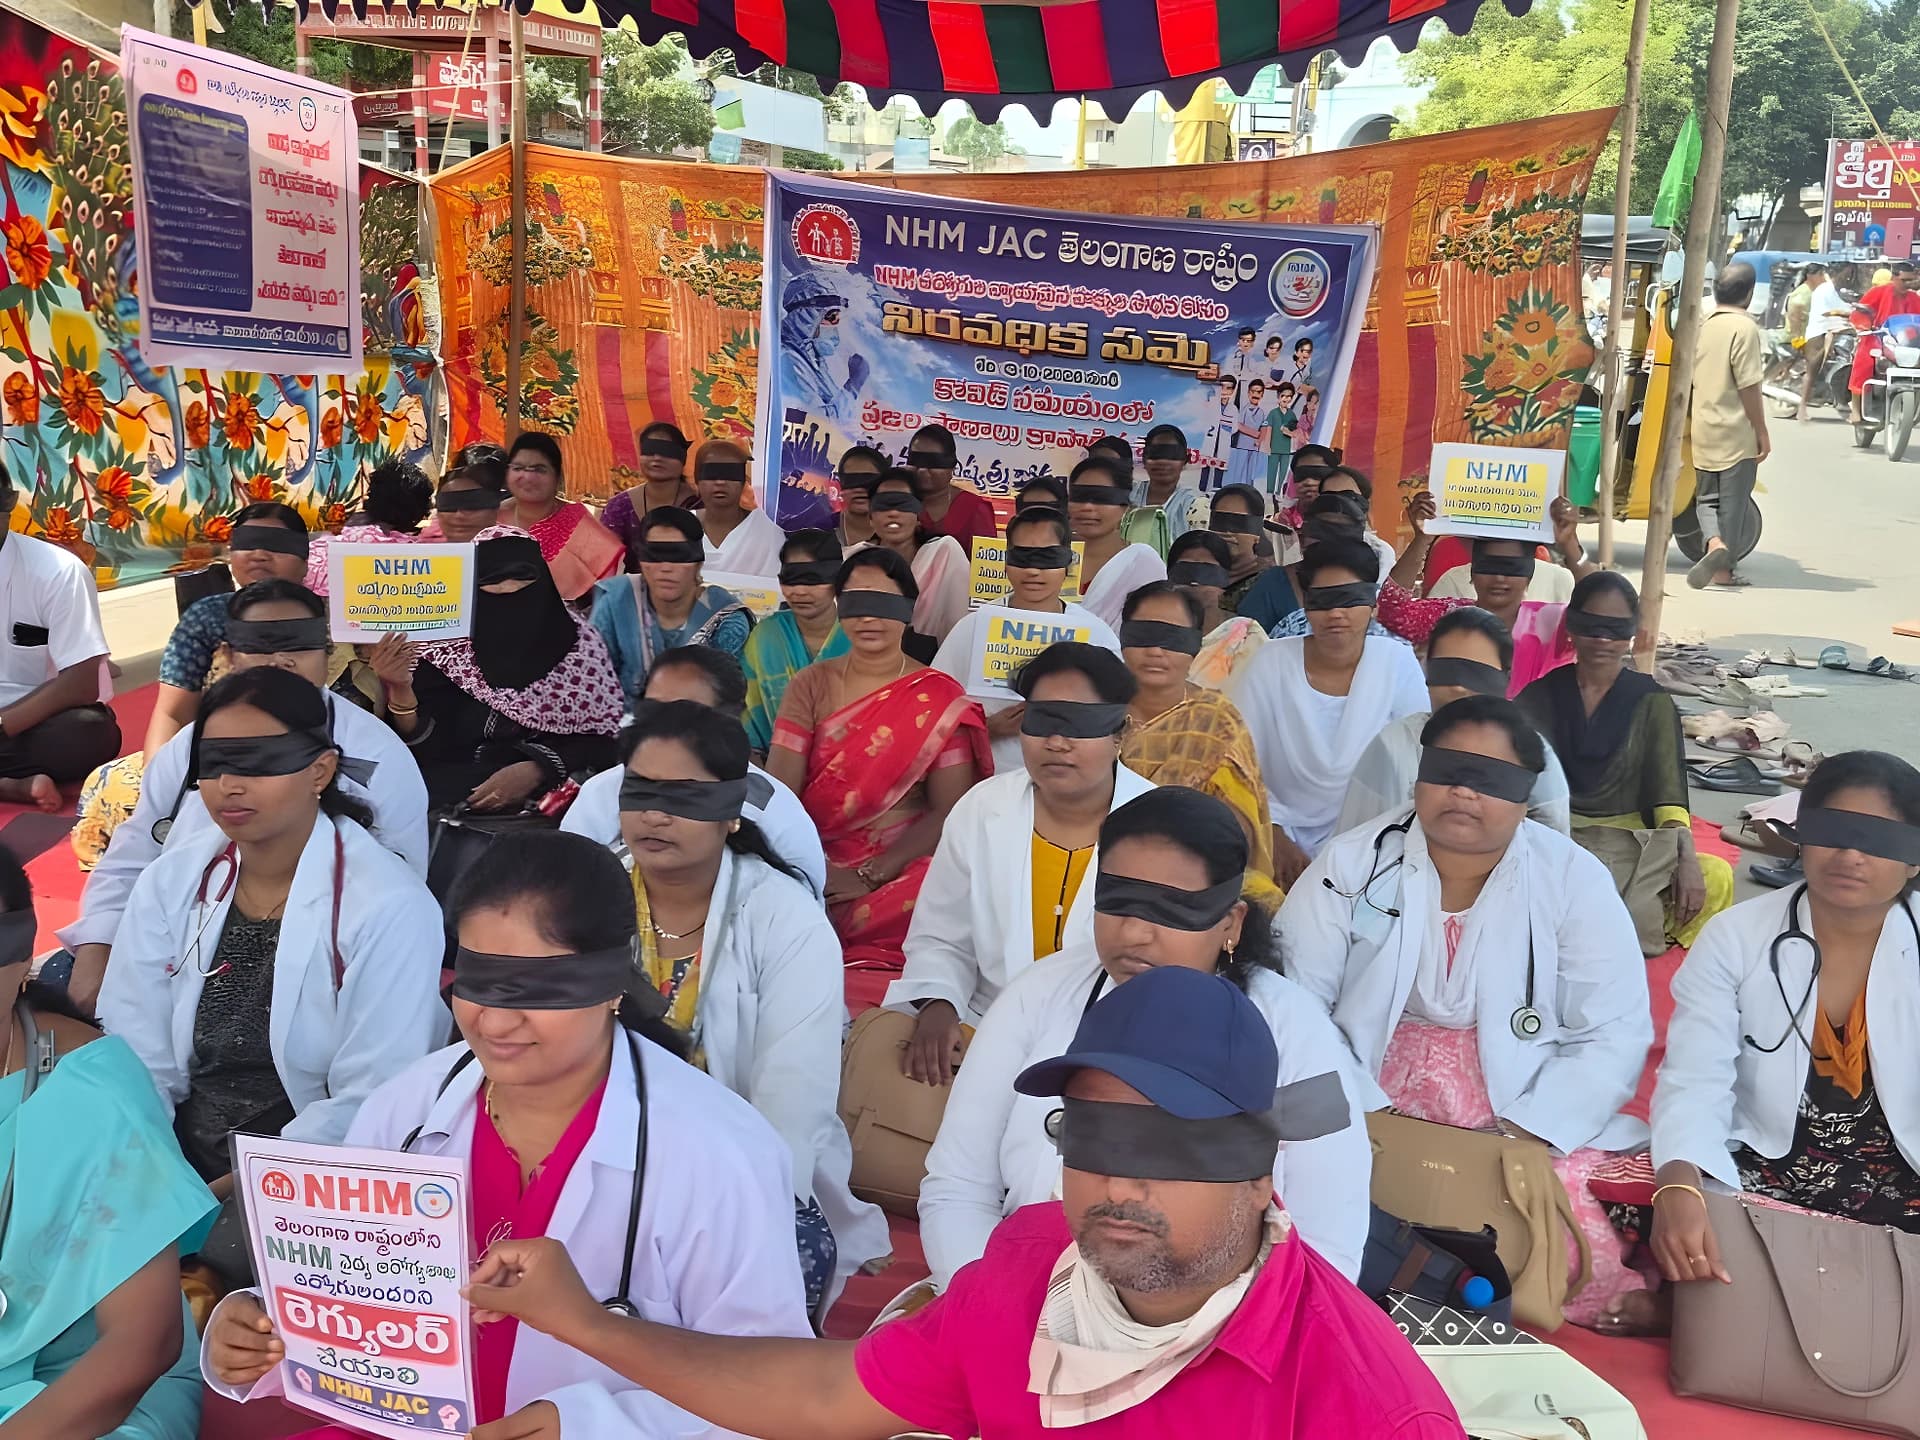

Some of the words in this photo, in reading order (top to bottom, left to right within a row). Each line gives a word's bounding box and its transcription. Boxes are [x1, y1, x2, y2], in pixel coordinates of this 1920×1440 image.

[885, 214, 966, 253] NHM
[977, 224, 1048, 260] JAC
[1058, 231, 1176, 273] తెలంగాణ
[875, 265, 917, 290] NHM
[882, 302, 1089, 357] నిరవధిక
[1101, 326, 1220, 380] సమ్మె
[860, 400, 922, 432] ప్రజల
[933, 378, 1010, 408] కోవిడ్
[1012, 384, 1155, 425] సమయంలో
[1466, 461, 1528, 483] NHM
[374, 558, 431, 575] NHM
[1001, 619, 1076, 645] NHM
[303, 1173, 413, 1217] NHM
[274, 1216, 350, 1241] తెలంగాణ
[354, 1227, 442, 1256] రాష్ట్రంలోని
[265, 1235, 333, 1271] NHM
[339, 1253, 373, 1280] వైద్య
[282, 1292, 450, 1357] రెగ్యులర్
[316, 1347, 420, 1385] చేయాలి
[318, 1372, 374, 1404] NHM
[379, 1391, 430, 1416] JAC
